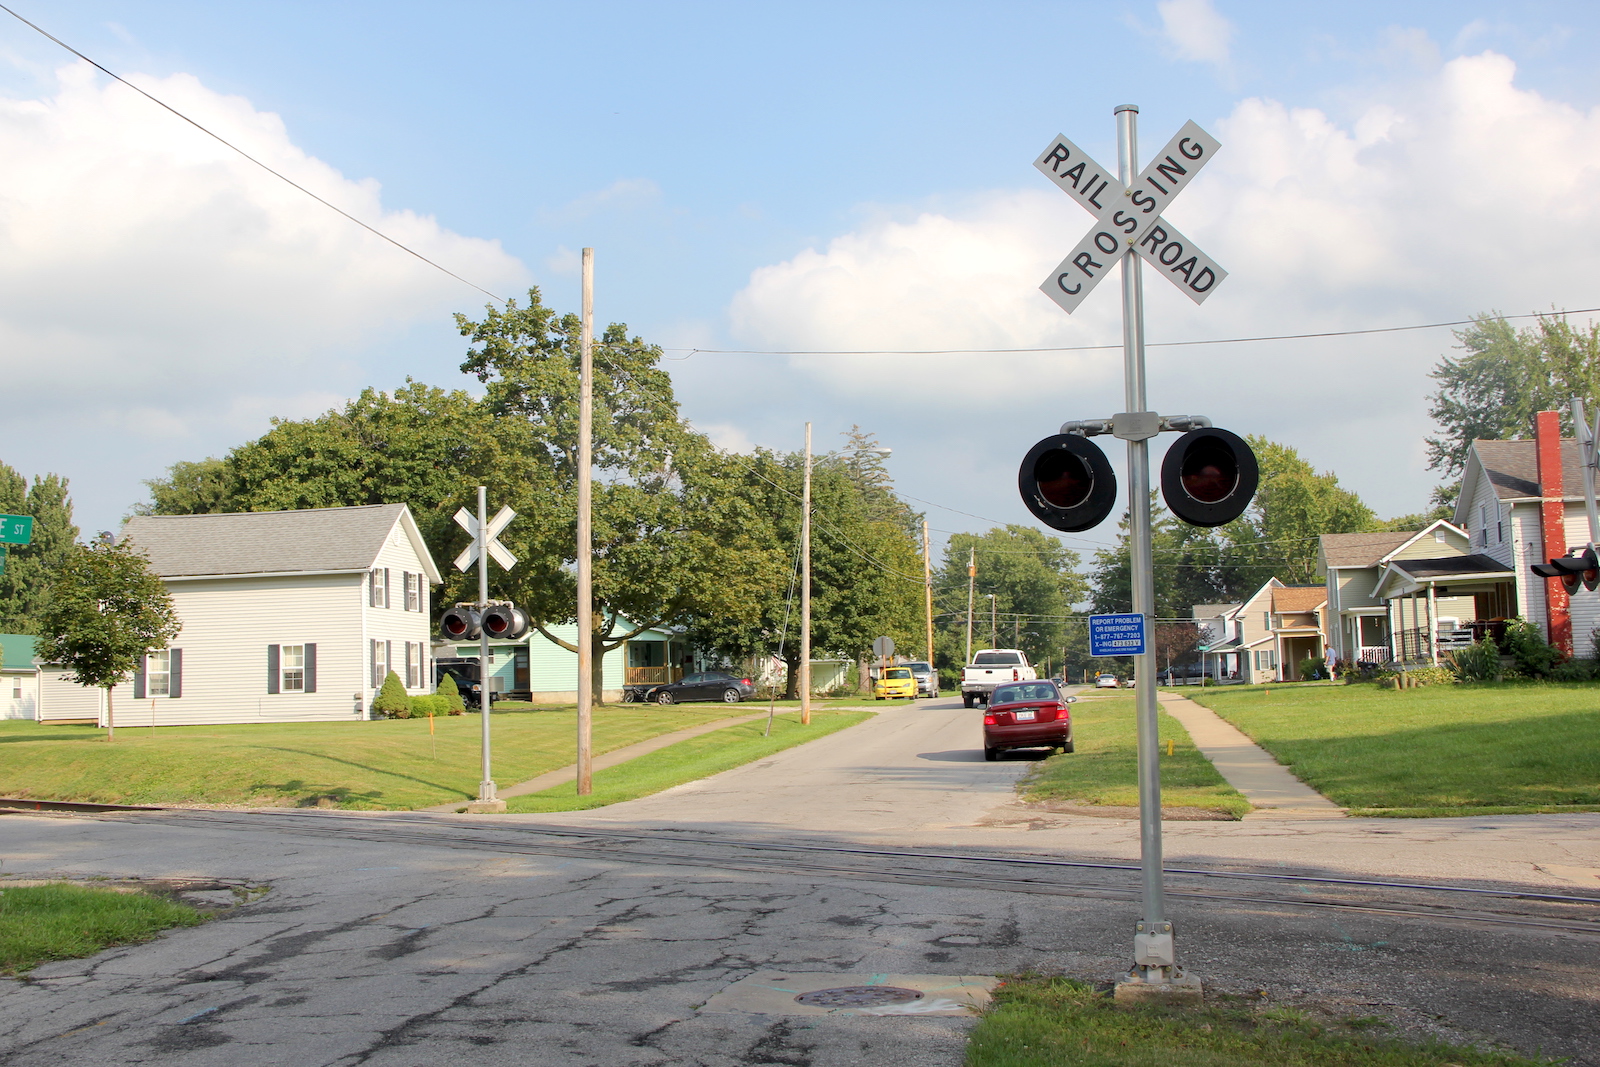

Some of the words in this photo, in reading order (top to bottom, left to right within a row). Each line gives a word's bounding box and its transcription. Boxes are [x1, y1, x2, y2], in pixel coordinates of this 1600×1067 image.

[1043, 142, 1109, 210] RAIL
[1140, 225, 1216, 293] ROAD
[1057, 137, 1204, 295] CROSSING
[14, 524, 25, 535] ST
